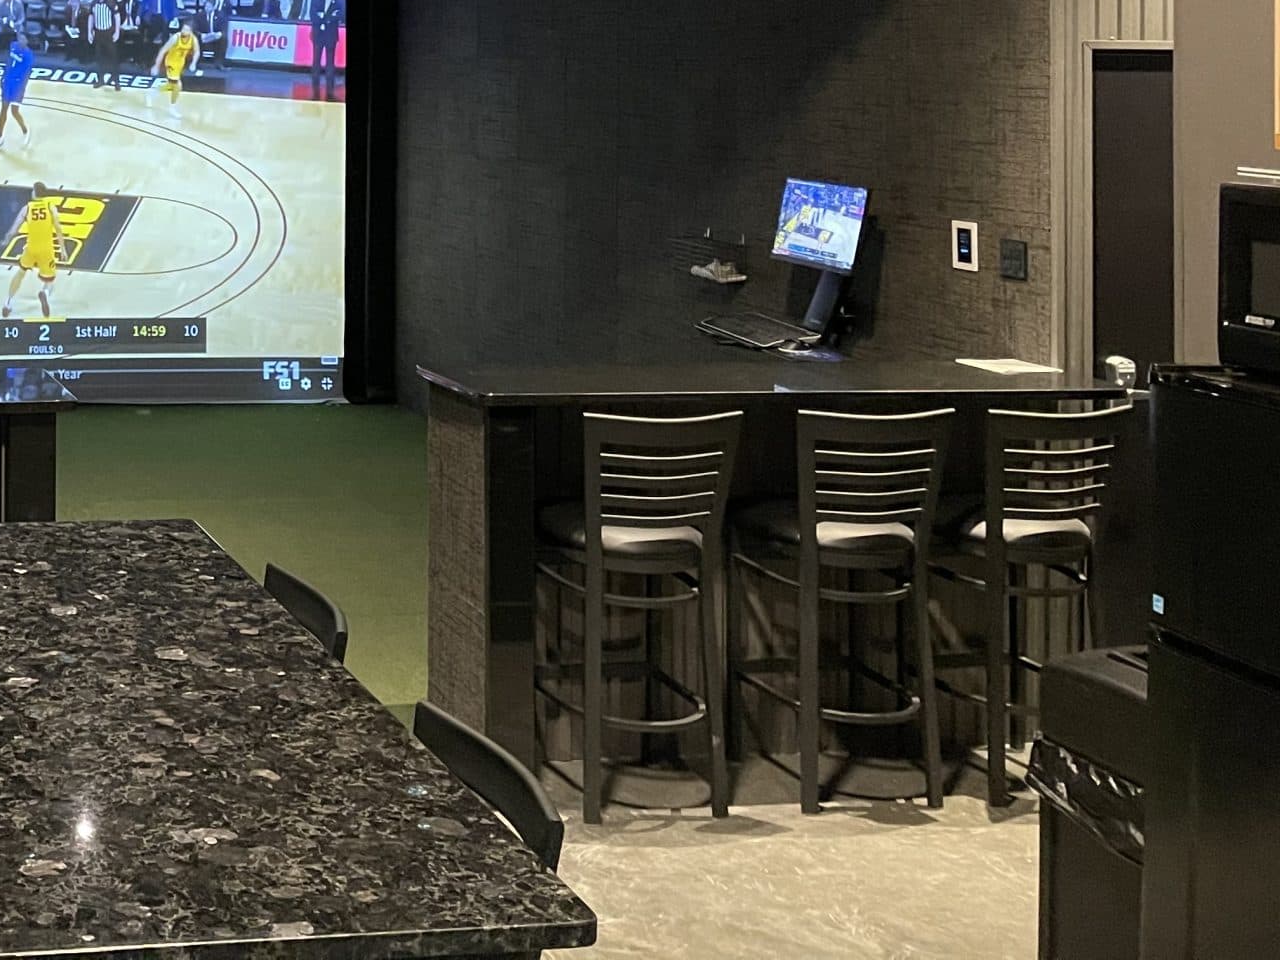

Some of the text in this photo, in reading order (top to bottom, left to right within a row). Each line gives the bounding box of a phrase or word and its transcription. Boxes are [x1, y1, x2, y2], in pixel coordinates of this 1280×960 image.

[31, 207, 47, 221] 55
[4, 327, 19, 339] 1-0
[38, 324, 51, 342] 2
[75, 326, 91, 339] 1st
[94, 325, 117, 338] Half
[132, 325, 167, 338] 14:59
[183, 324, 199, 338] 10
[28, 345, 56, 355] FOULS:
[57, 368, 82, 380] Year
[262, 360, 300, 381] FS1
